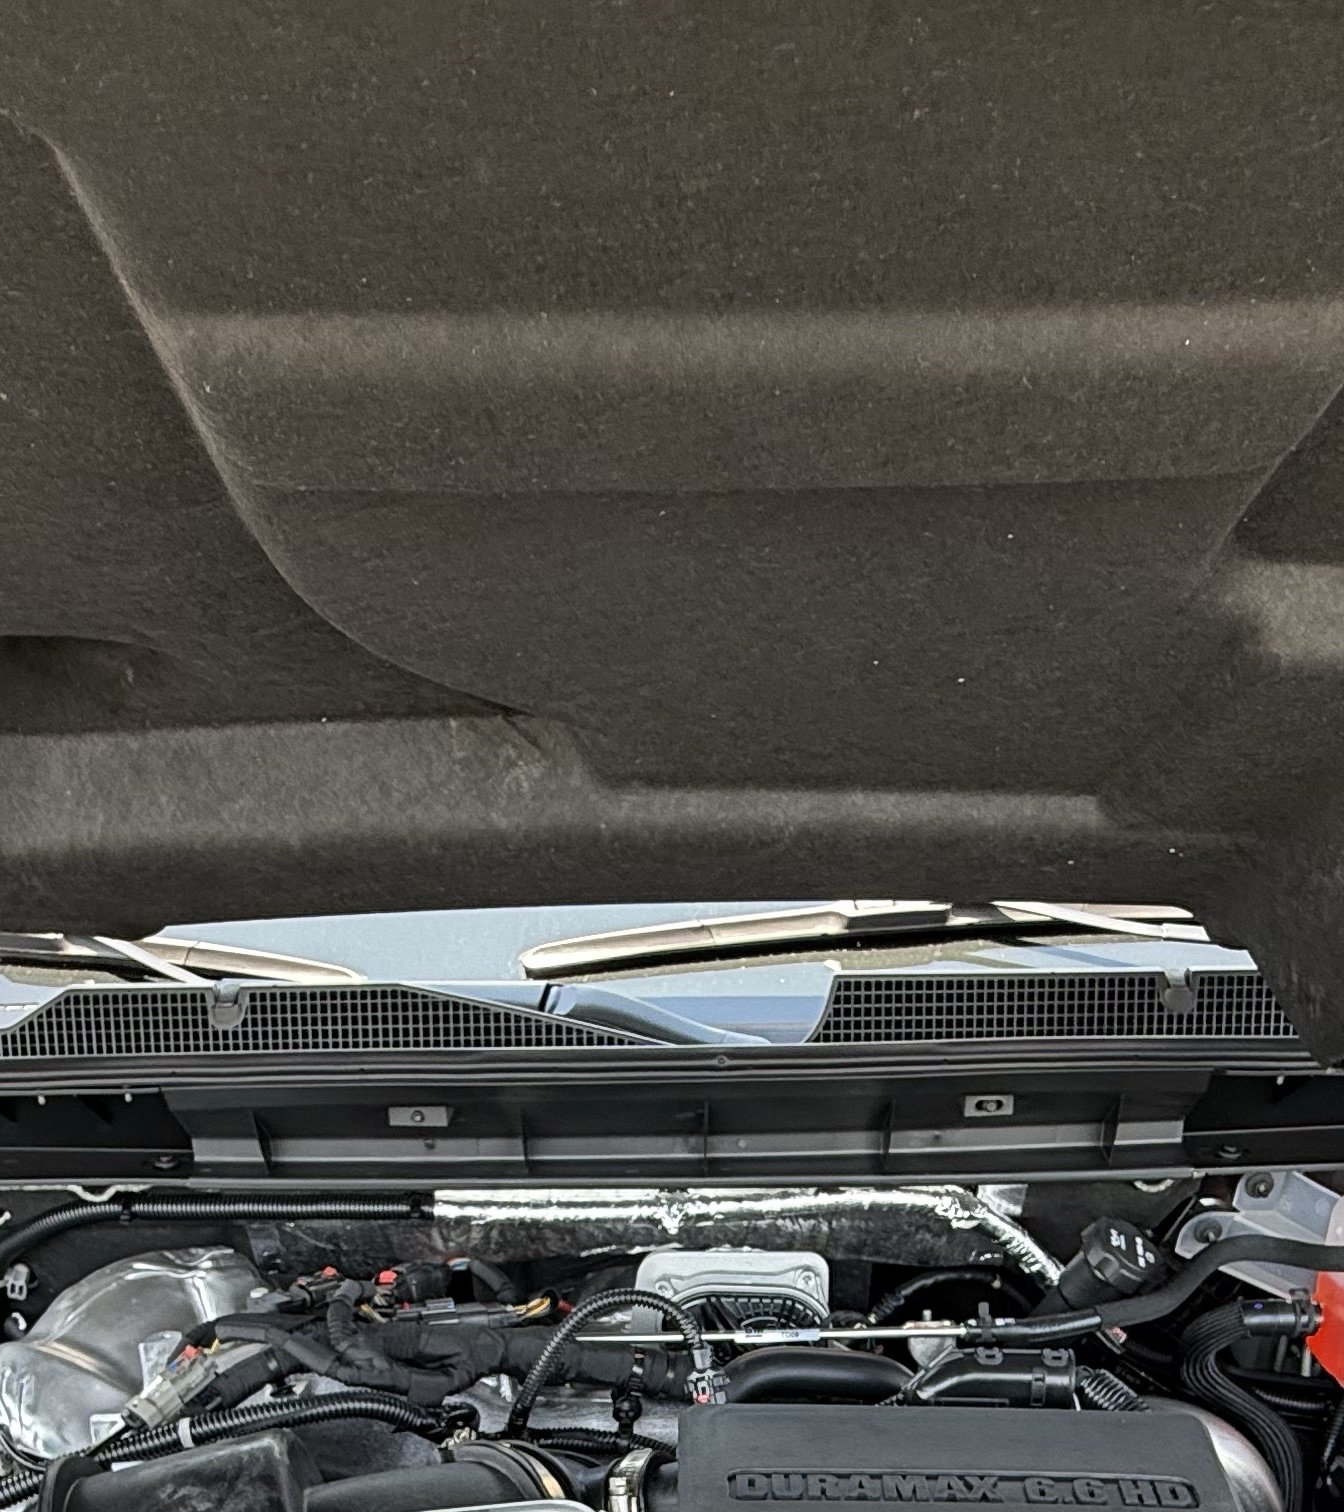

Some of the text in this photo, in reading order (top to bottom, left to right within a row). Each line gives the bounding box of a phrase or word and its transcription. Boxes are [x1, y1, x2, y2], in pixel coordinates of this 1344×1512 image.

[734, 1473, 1200, 1509] DURAMAX 6.6 HD
